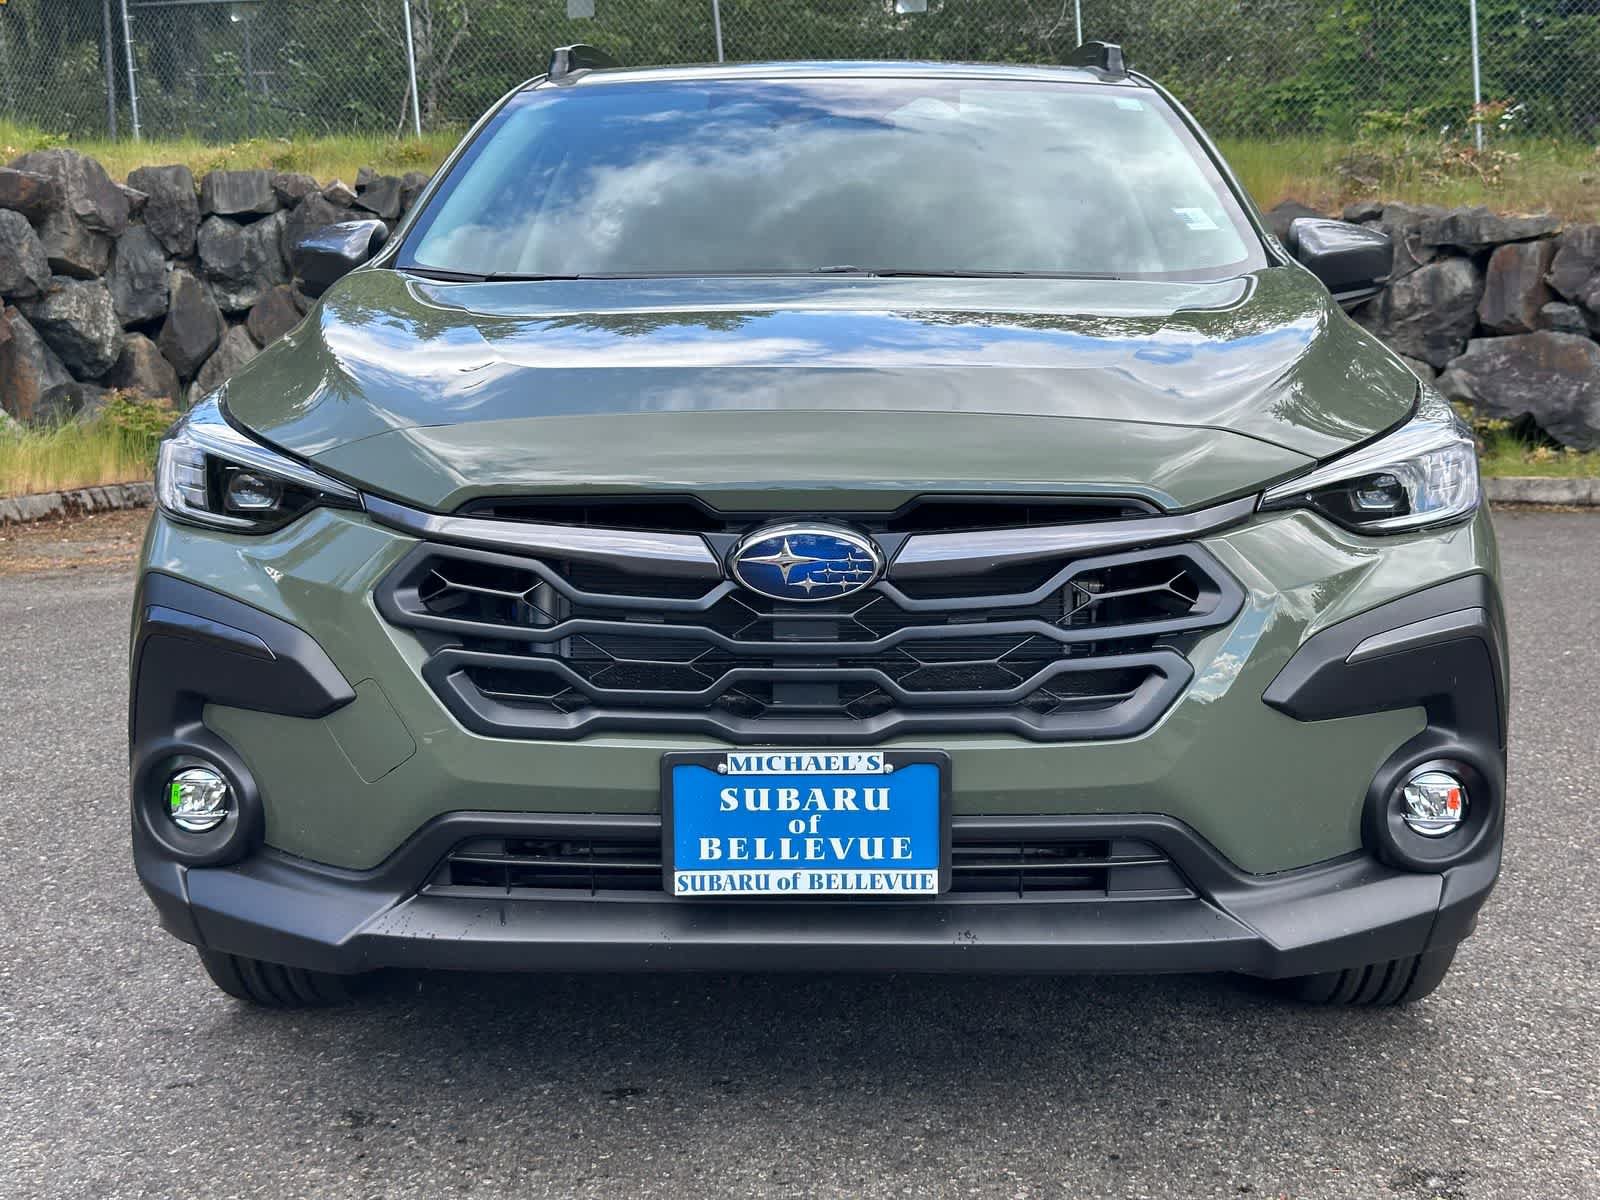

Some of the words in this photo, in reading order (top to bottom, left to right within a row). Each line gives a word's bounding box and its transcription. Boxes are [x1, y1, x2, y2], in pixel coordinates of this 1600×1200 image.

[730, 754, 881, 772] MICHAEL'S
[719, 787, 890, 812] SUBARU
[788, 814, 822, 835] of
[698, 836, 913, 861] BELLEVUE
[677, 874, 770, 892] SUBARU
[777, 873, 801, 891] of
[808, 873, 934, 891] BELLEVUE
